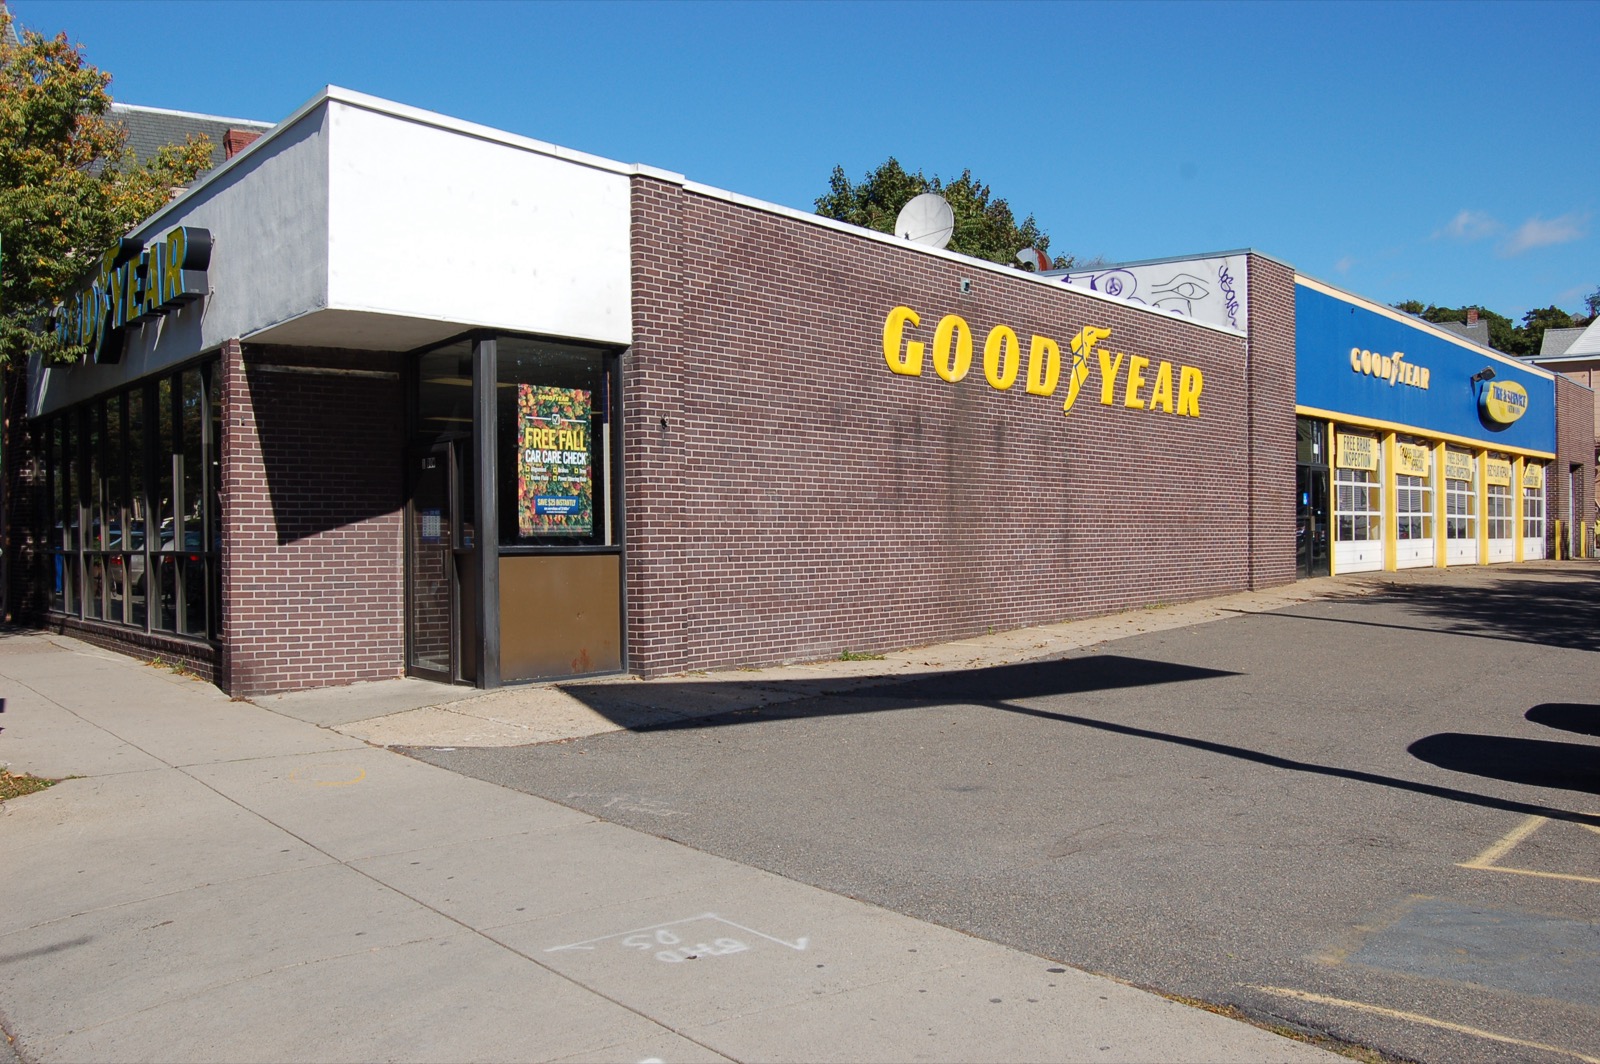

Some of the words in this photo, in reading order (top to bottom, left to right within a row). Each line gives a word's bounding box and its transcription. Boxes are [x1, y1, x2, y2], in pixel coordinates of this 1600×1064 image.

[882, 305, 1204, 418] GOODYEAR
[1349, 347, 1431, 390] GOODYEAR
[525, 427, 557, 450] FREE
[559, 429, 587, 451] FALL
[1343, 435, 1355, 451] FREE
[1356, 437, 1371, 453] BRAKE
[525, 449, 541, 463] CAR
[542, 450, 562, 464] CARE
[1343, 451, 1371, 468] INSPECTION
